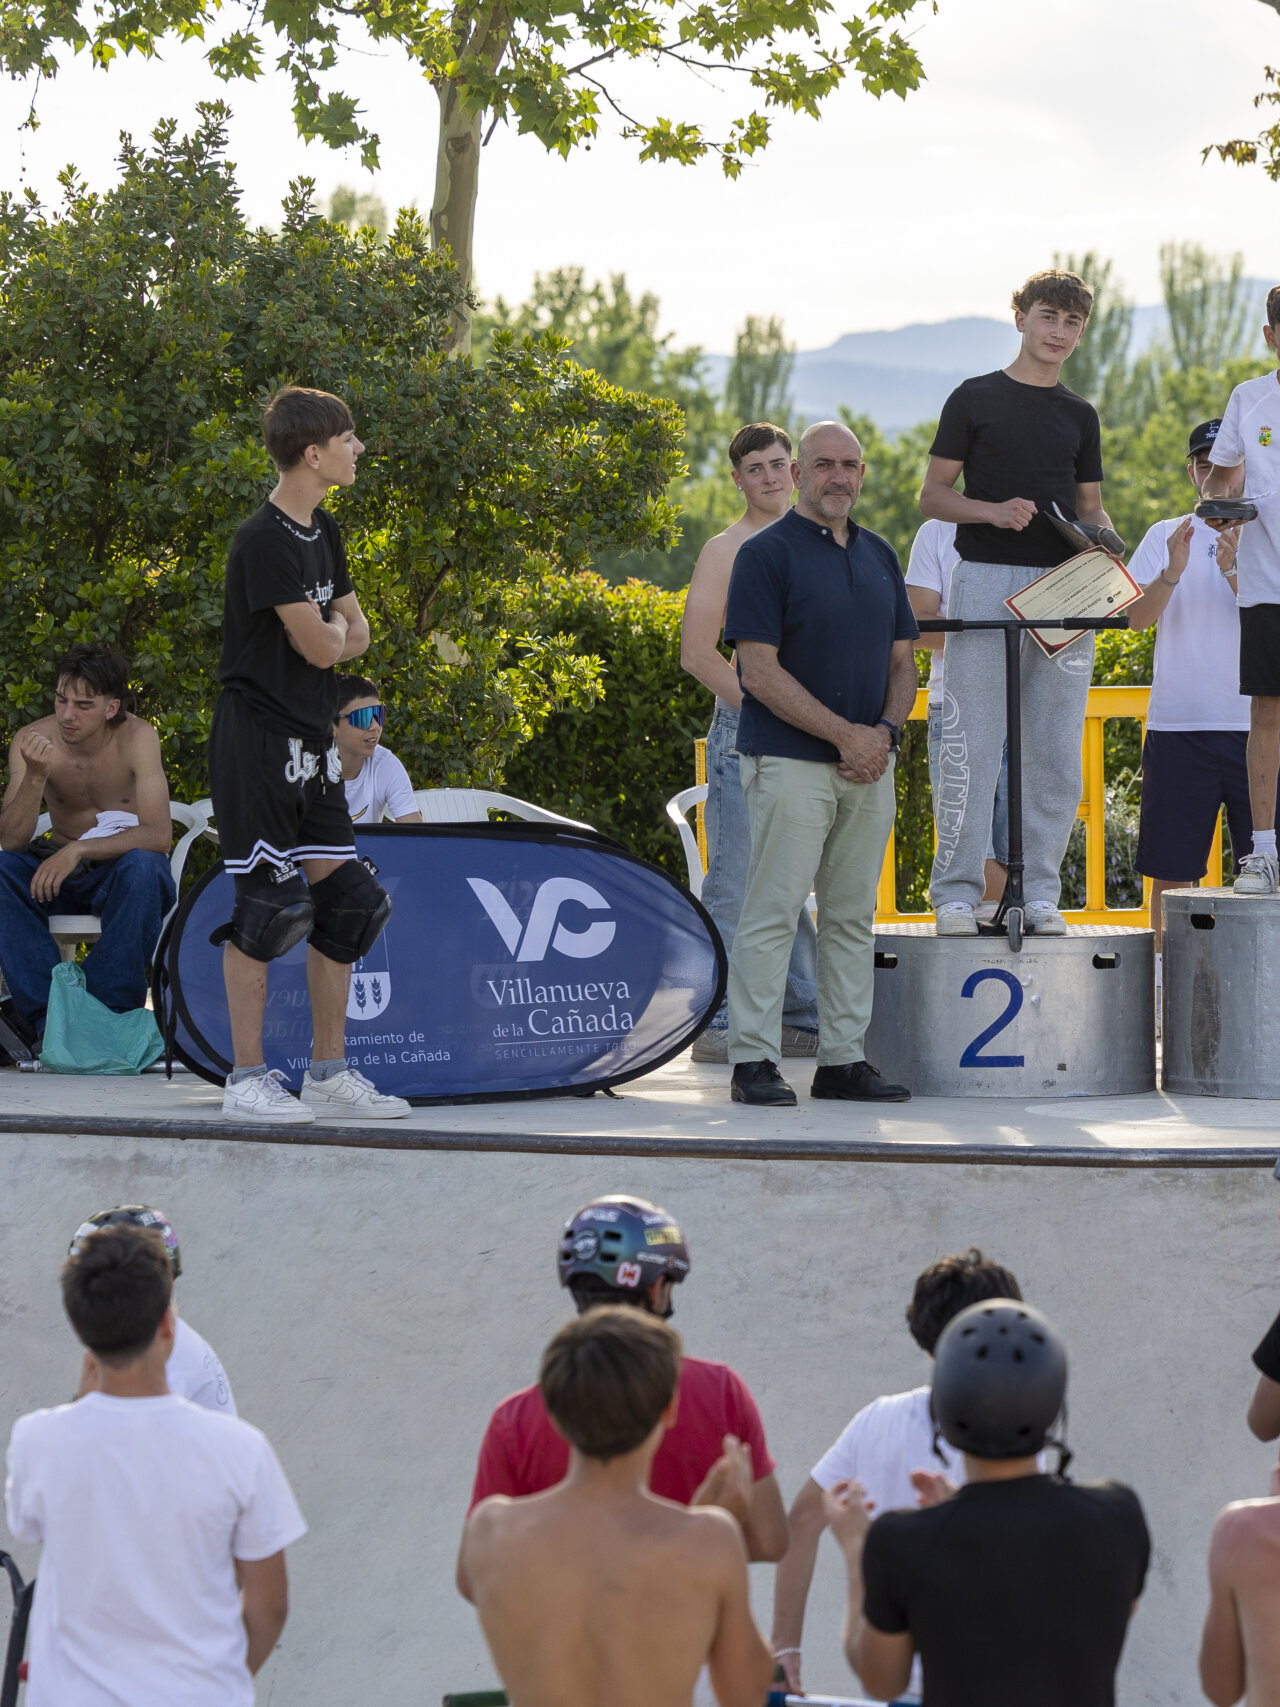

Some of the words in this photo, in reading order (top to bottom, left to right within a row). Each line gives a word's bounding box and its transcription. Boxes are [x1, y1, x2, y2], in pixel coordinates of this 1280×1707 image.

[466, 877, 616, 962] VC
[486, 977, 631, 1006] Villanueva
[493, 1024, 509, 1038] de
[512, 1024, 524, 1037] la
[528, 1005, 635, 1036] Cañada
[960, 968, 1024, 1067] 2
[408, 1030, 424, 1043] de
[495, 1044, 599, 1060] SENCILLAMENTE
[606, 1041, 637, 1051] TODO
[364, 1053, 380, 1065] de
[384, 1052, 397, 1064] la
[401, 1049, 451, 1063] Cañada
